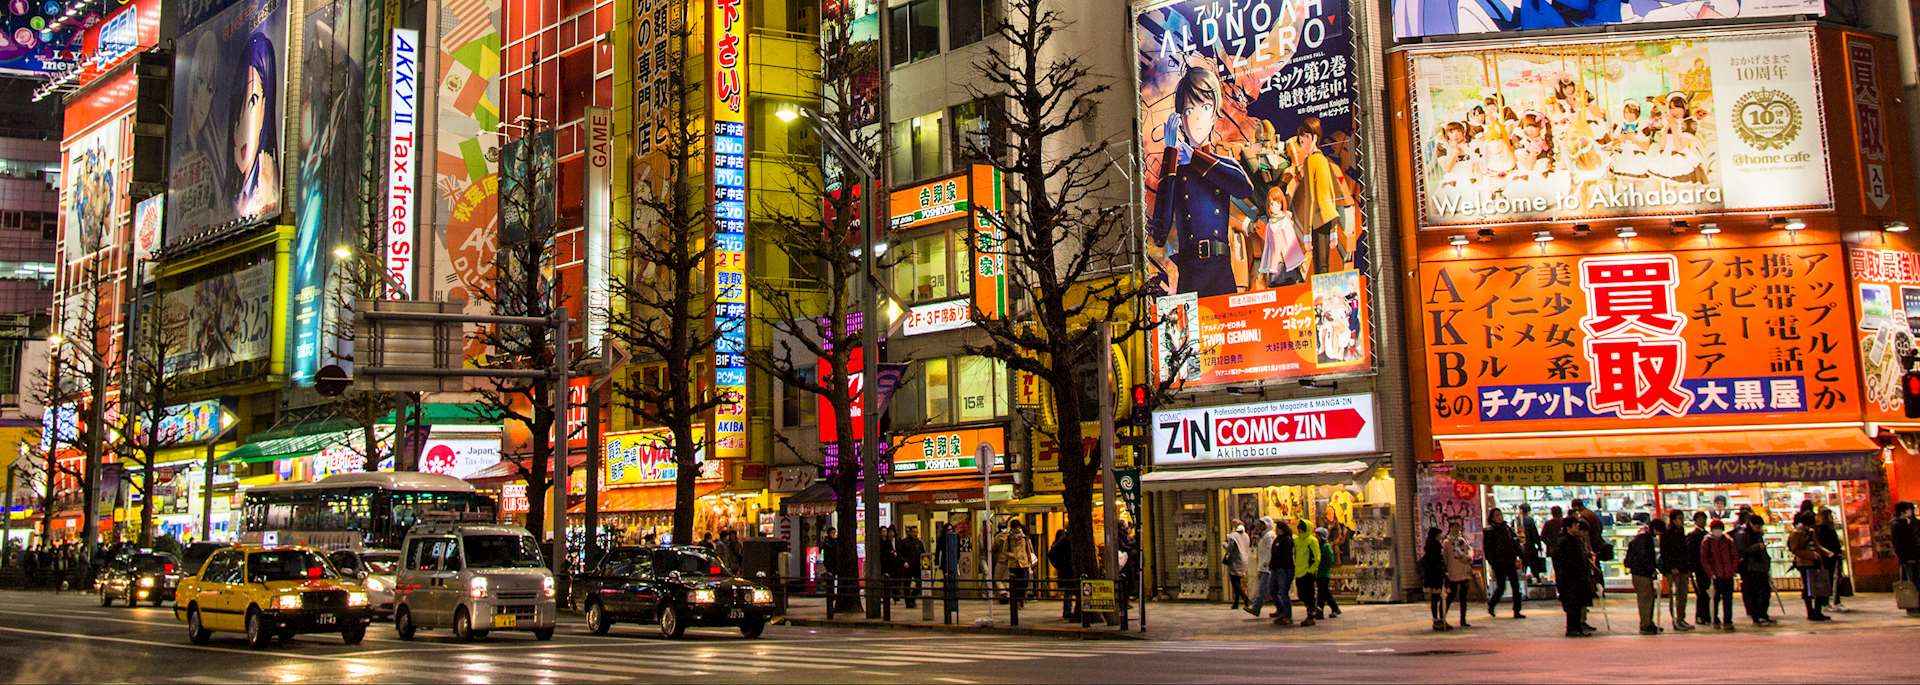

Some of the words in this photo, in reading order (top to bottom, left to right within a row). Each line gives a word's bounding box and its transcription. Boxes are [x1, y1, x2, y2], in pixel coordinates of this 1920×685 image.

[396, 34, 415, 110] AKKY
[1260, 55, 1347, 93] コミック第2巻
[1730, 54, 1790, 66] おかげさまで
[1736, 65, 1789, 81] 10周年
[1279, 78, 1348, 109] 絶賛発売中!
[1848, 41, 1886, 161] 買取
[592, 115, 608, 168] GAME
[717, 141, 743, 154] DVD
[391, 131, 414, 235] Tax-free
[717, 173, 743, 187] DVD
[1432, 192, 1549, 217] Welcome
[1552, 190, 1580, 212] to
[1588, 183, 1723, 211] Akihabara
[1263, 304, 1311, 320] アンソロジー
[1504, 264, 1539, 348] アニメ
[1724, 256, 1758, 340] ホビー
[1760, 253, 1804, 373] 携帯電話
[1282, 315, 1312, 330] コミック
[1469, 265, 1508, 378] アイドル
[1538, 262, 1579, 380] 美少女系
[1688, 258, 1728, 376] フィギュア
[1797, 252, 1847, 411] アップルとか
[1582, 257, 1692, 416] 買取
[1247, 405, 1270, 415] Support
[1270, 404, 1279, 412] for
[1279, 401, 1309, 412] Magazine
[1482, 386, 1584, 418] チケット
[1697, 379, 1802, 412] 大黒屋
[718, 421, 744, 433] AKIBA
[1160, 410, 1210, 458] ZIN
[1217, 417, 1290, 445] COMIC
[1294, 413, 1327, 440] ZIN
[1216, 446, 1278, 458] Akihabara
[1563, 463, 1633, 473] WESTERN
[1455, 465, 1494, 474] MONEY
[1501, 465, 1554, 474] TRANSFER
[1586, 472, 1632, 481] UNION
